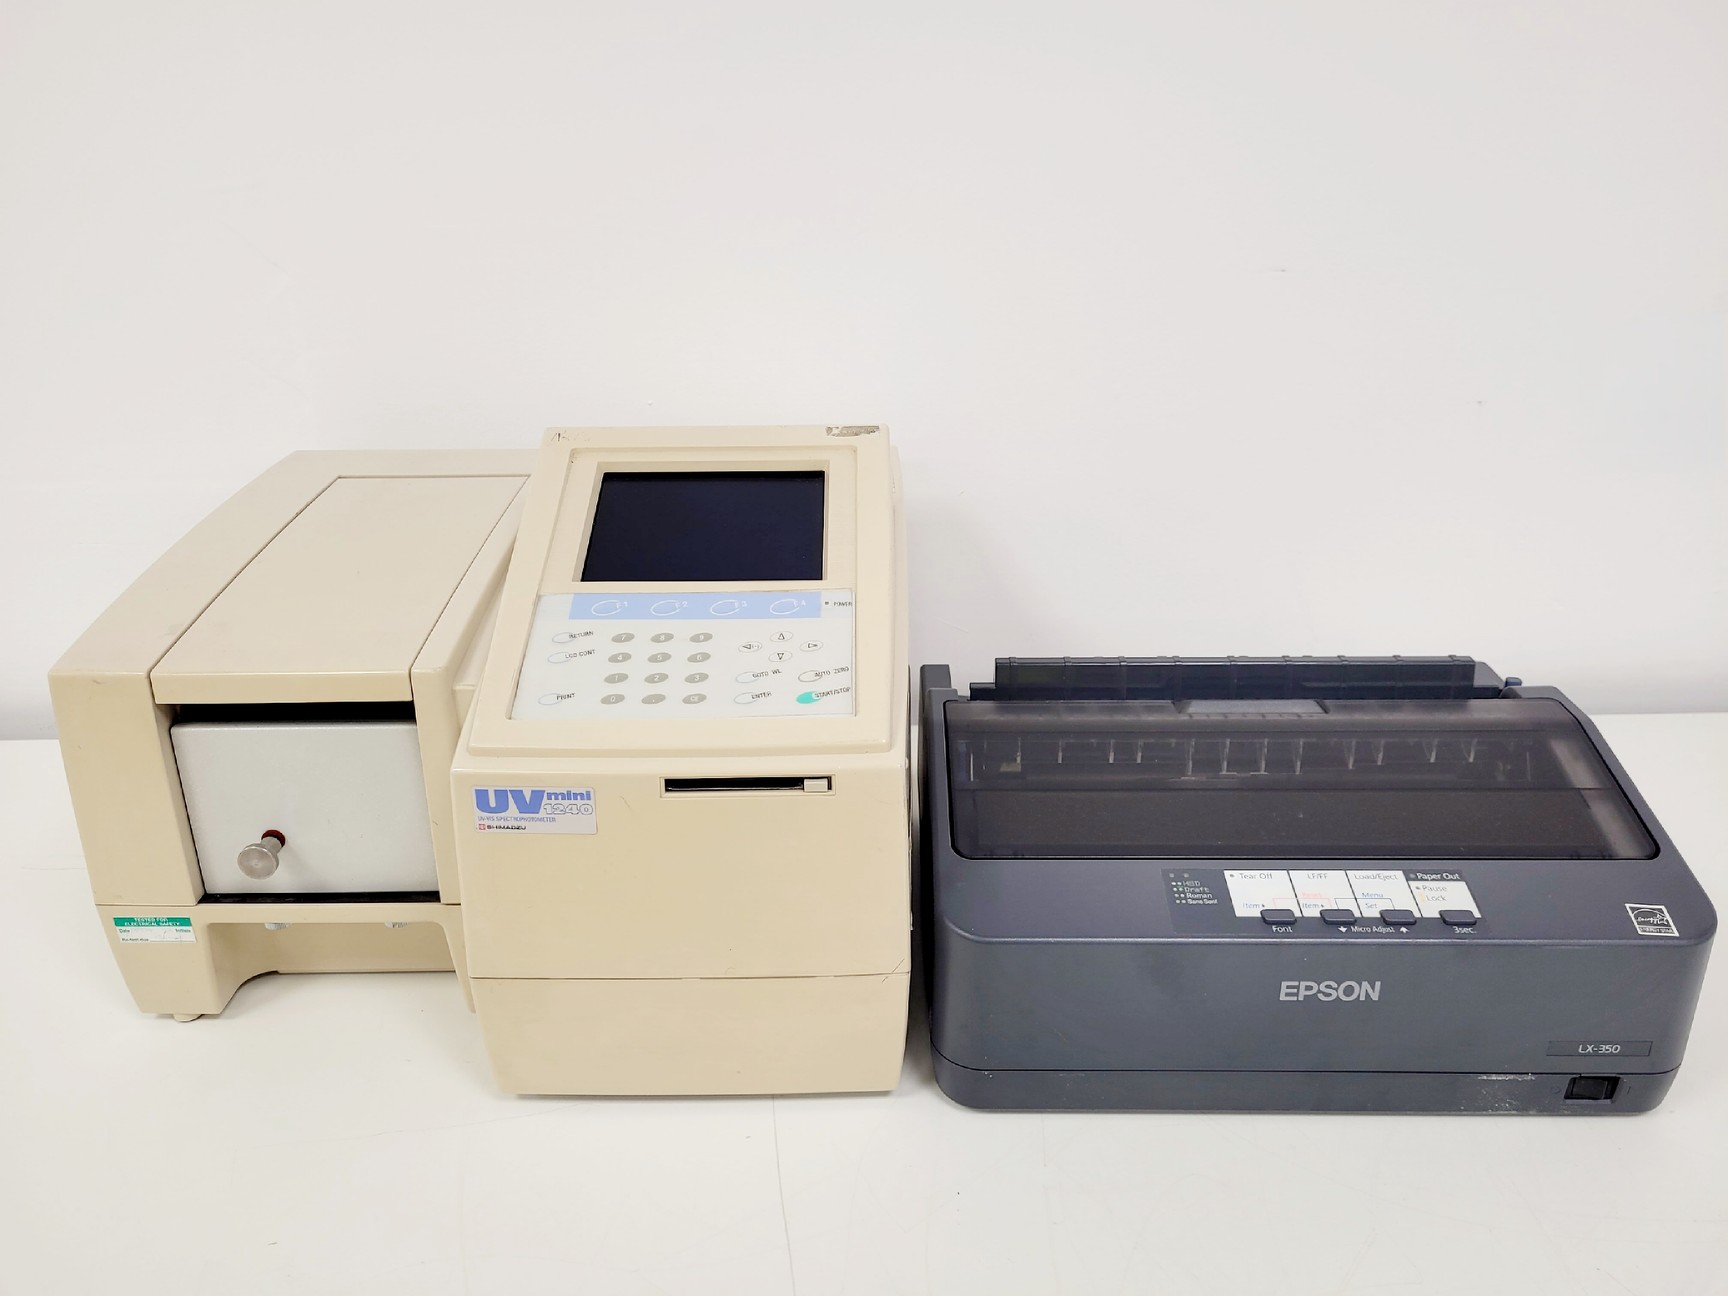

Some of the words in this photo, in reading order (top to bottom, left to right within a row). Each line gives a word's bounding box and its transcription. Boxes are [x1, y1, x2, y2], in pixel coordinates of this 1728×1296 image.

[568, 630, 594, 640] RETURN
[578, 649, 596, 658] CONT
[752, 671, 769, 679] GOTO
[814, 670, 831, 678] AUTO
[833, 666, 850, 675] ZERO
[556, 692, 576, 701] PRINT
[751, 691, 772, 700] ENTER
[814, 686, 851, 699] START/STOP
[474, 789, 546, 814] UV
[546, 790, 592, 801] mini
[543, 803, 594, 816] 1240
[1354, 873, 1399, 881] Load/Eject
[1416, 873, 1442, 881] Paper
[1271, 925, 1293, 933] Font
[1372, 926, 1396, 934] Adjust
[1279, 980, 1381, 1001] EPSON
[1578, 1044, 1621, 1054] LX-350
